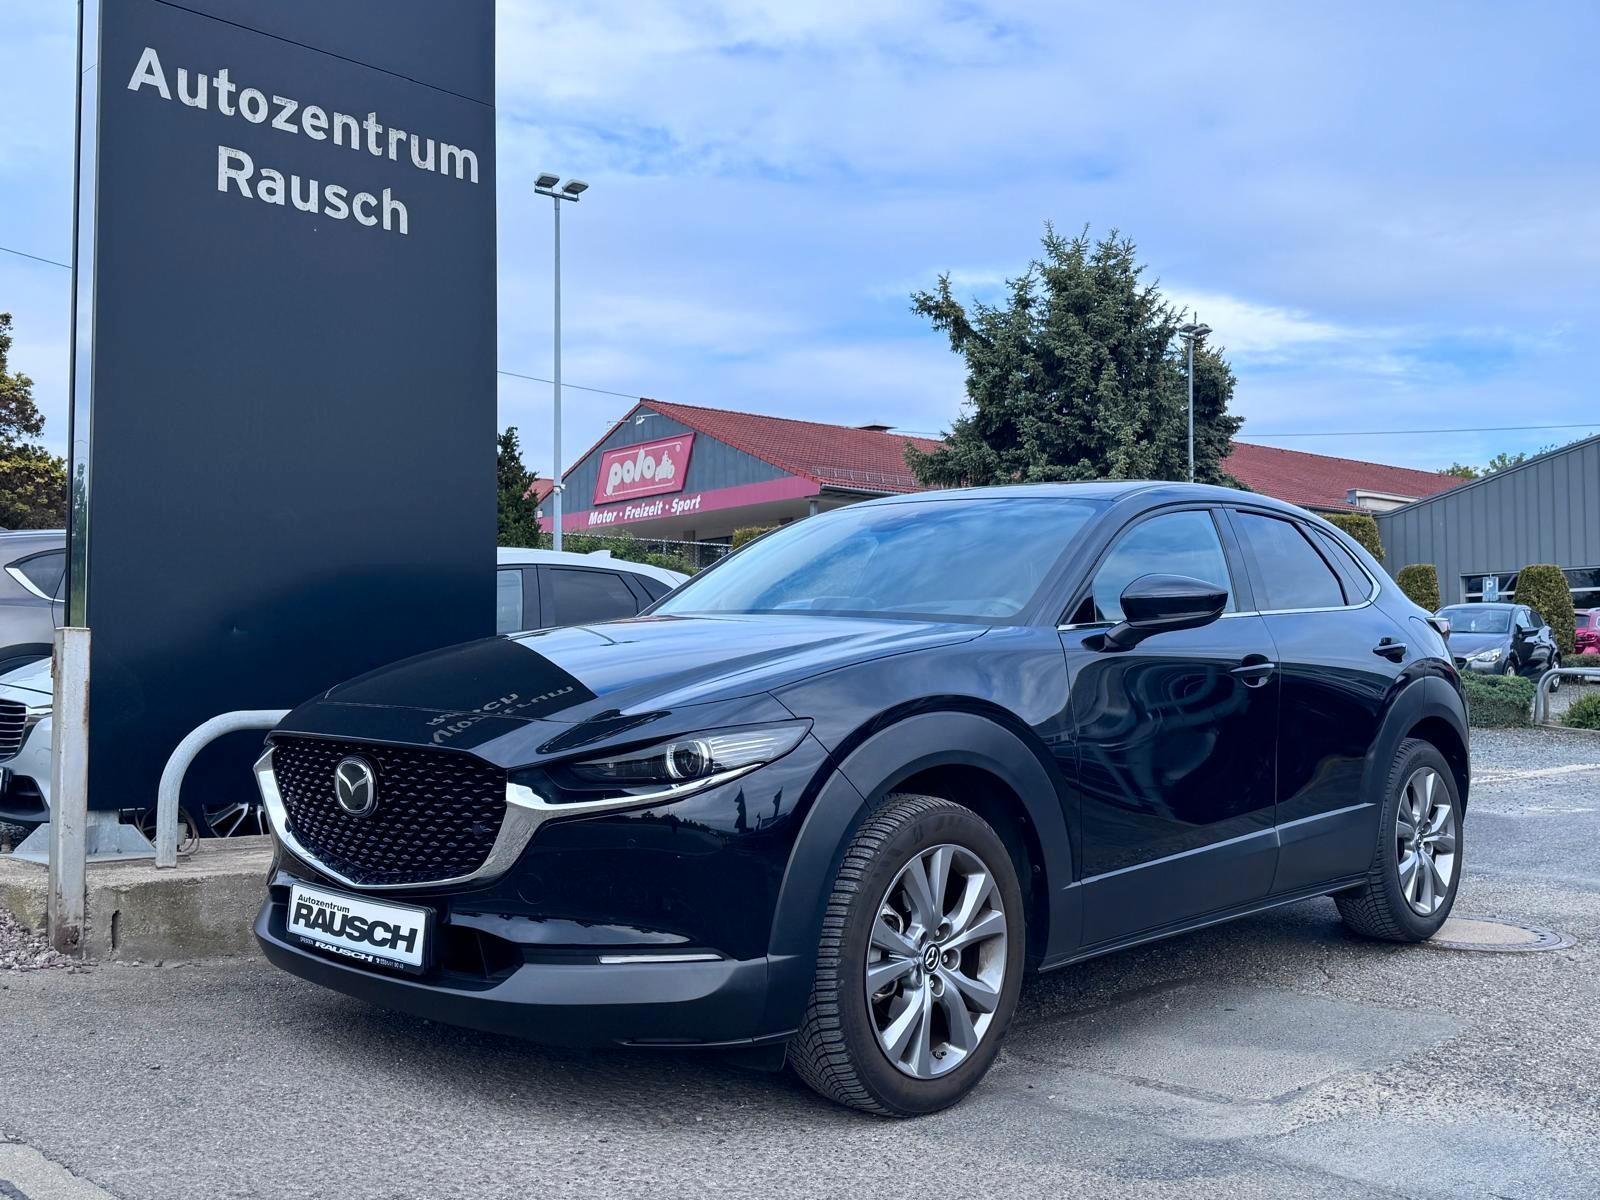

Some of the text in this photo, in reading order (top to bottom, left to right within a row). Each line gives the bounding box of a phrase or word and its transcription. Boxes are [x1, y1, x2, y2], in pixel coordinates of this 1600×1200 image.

[127, 46, 479, 184] Autozentrum
[217, 145, 409, 235] Rausch
[605, 448, 656, 496] polo
[588, 494, 701, 526] Motor Freizeit Sport
[1486, 580, 1494, 591] P
[292, 901, 418, 954] RAUSCH
[298, 893, 350, 914] Autozentrum
